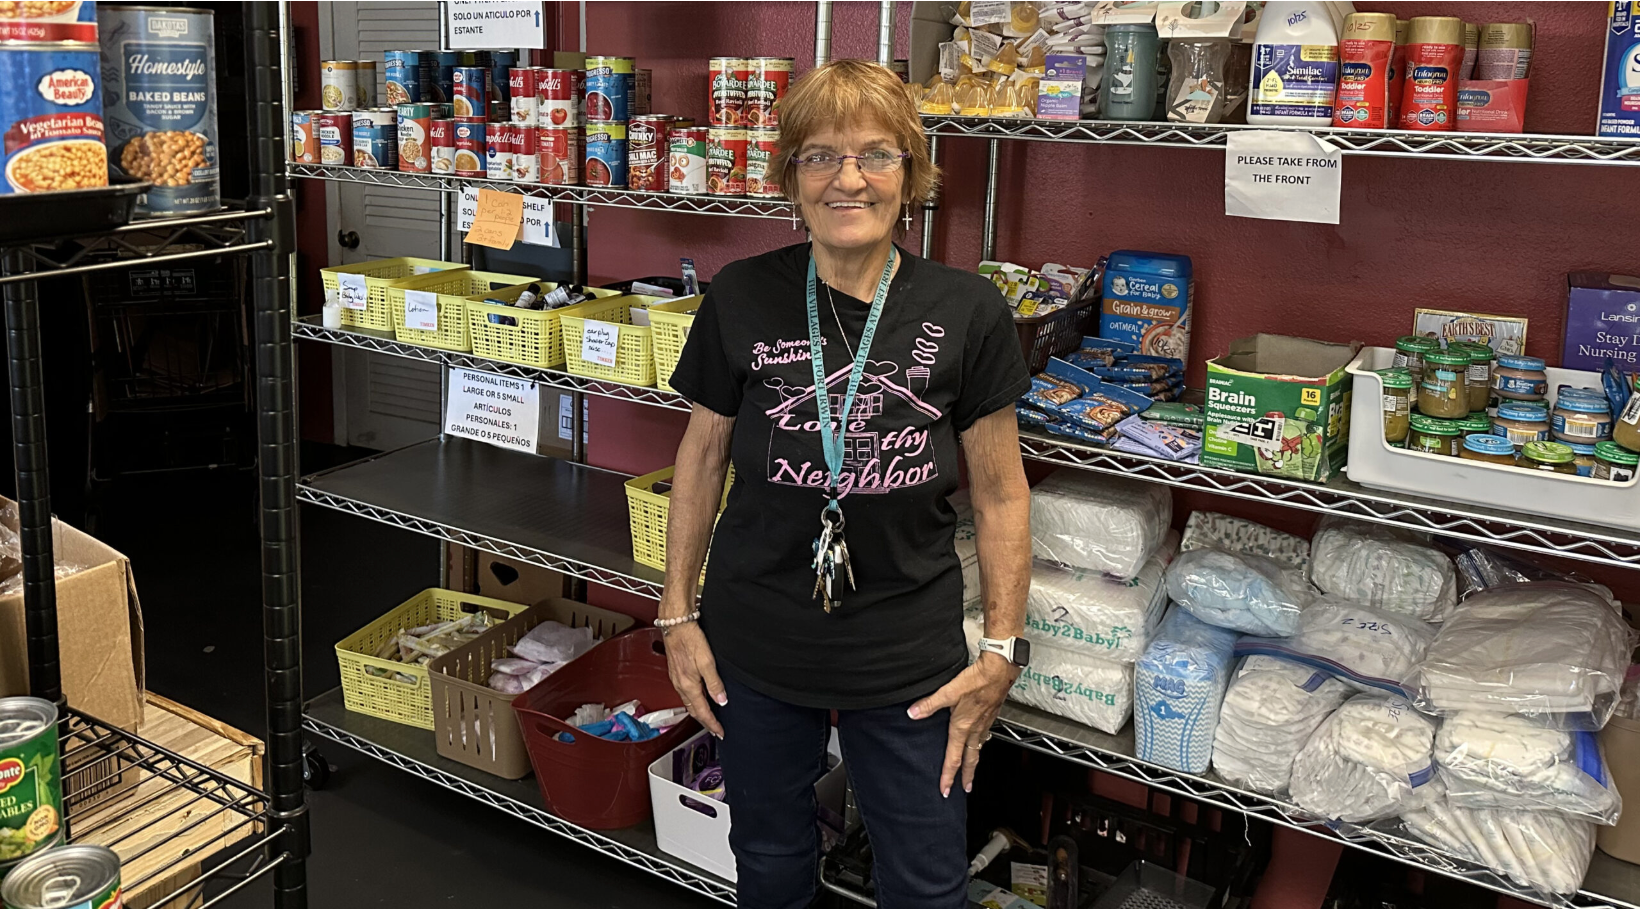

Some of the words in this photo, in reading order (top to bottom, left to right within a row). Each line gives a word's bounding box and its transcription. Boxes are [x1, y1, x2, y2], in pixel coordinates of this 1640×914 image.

[453, 12, 472, 21] SOLO
[473, 12, 484, 20] UN
[484, 10, 515, 20] ATICULO
[515, 10, 531, 19] POR
[151, 20, 185, 31] DAKOTAS
[454, 26, 484, 35] ESTANTE
[128, 54, 206, 81] Homestyle
[1286, 65, 1323, 75] Similac
[48, 75, 90, 89] American
[712, 79, 747, 91] BOYARDEE
[53, 88, 87, 101] Beauty
[128, 92, 171, 102] BAKED
[172, 92, 206, 102] BEANS
[20, 115, 84, 134] Vegetarian
[43, 126, 81, 138] Tomato
[639, 151, 657, 160] MAC
[1237, 155, 1275, 166] PLEASE
[1276, 157, 1303, 167] TAKE
[1305, 158, 1337, 169] FROM
[1252, 173, 1273, 183] THE
[1275, 174, 1311, 185] FRONT
[526, 218, 542, 227] POR
[880, 258, 895, 286] IRWIN
[807, 277, 816, 299] THE
[1129, 281, 1159, 293] Cereal
[872, 287, 887, 313] FORT
[1142, 291, 1161, 300] Baby
[407, 302, 429, 314] Lotion
[1112, 300, 1141, 316] Grain
[808, 298, 821, 348] VILLAGES
[869, 311, 879, 326] AT
[1109, 321, 1140, 333] OATMEAL
[1441, 321, 1475, 338] EARTH'S
[1474, 321, 1496, 337] BEST
[1596, 330, 1629, 348] Stay
[752, 341, 772, 355] Be
[852, 326, 875, 376] VILLAGES
[1578, 344, 1637, 364] Nursing
[813, 349, 823, 365] AT
[463, 372, 499, 387] PERSONAL
[499, 379, 520, 390] ITEMS
[814, 364, 826, 390] FORT
[463, 385, 485, 397] LARGE
[485, 390, 496, 399] OR
[502, 393, 525, 405] SMALL
[848, 380, 859, 398] THE
[1306, 390, 1317, 400] 16
[1208, 387, 1256, 407] Brain
[473, 401, 512, 417] ARTÍCULOS
[817, 390, 832, 428] IRWIN
[1207, 400, 1256, 415] Squeezers
[465, 413, 512, 431] PERSONALES:
[776, 414, 866, 432] Loe
[1206, 410, 1241, 421] Applesauce
[1206, 416, 1222, 424] Brain
[450, 424, 480, 437] GRANDE
[480, 430, 487, 438] O
[492, 433, 531, 448] PEQUEÑOS
[881, 425, 929, 457] thy
[1207, 443, 1228, 452] Vitamin
[1051, 605, 1070, 623] 2
[1160, 705, 1166, 715] 1
